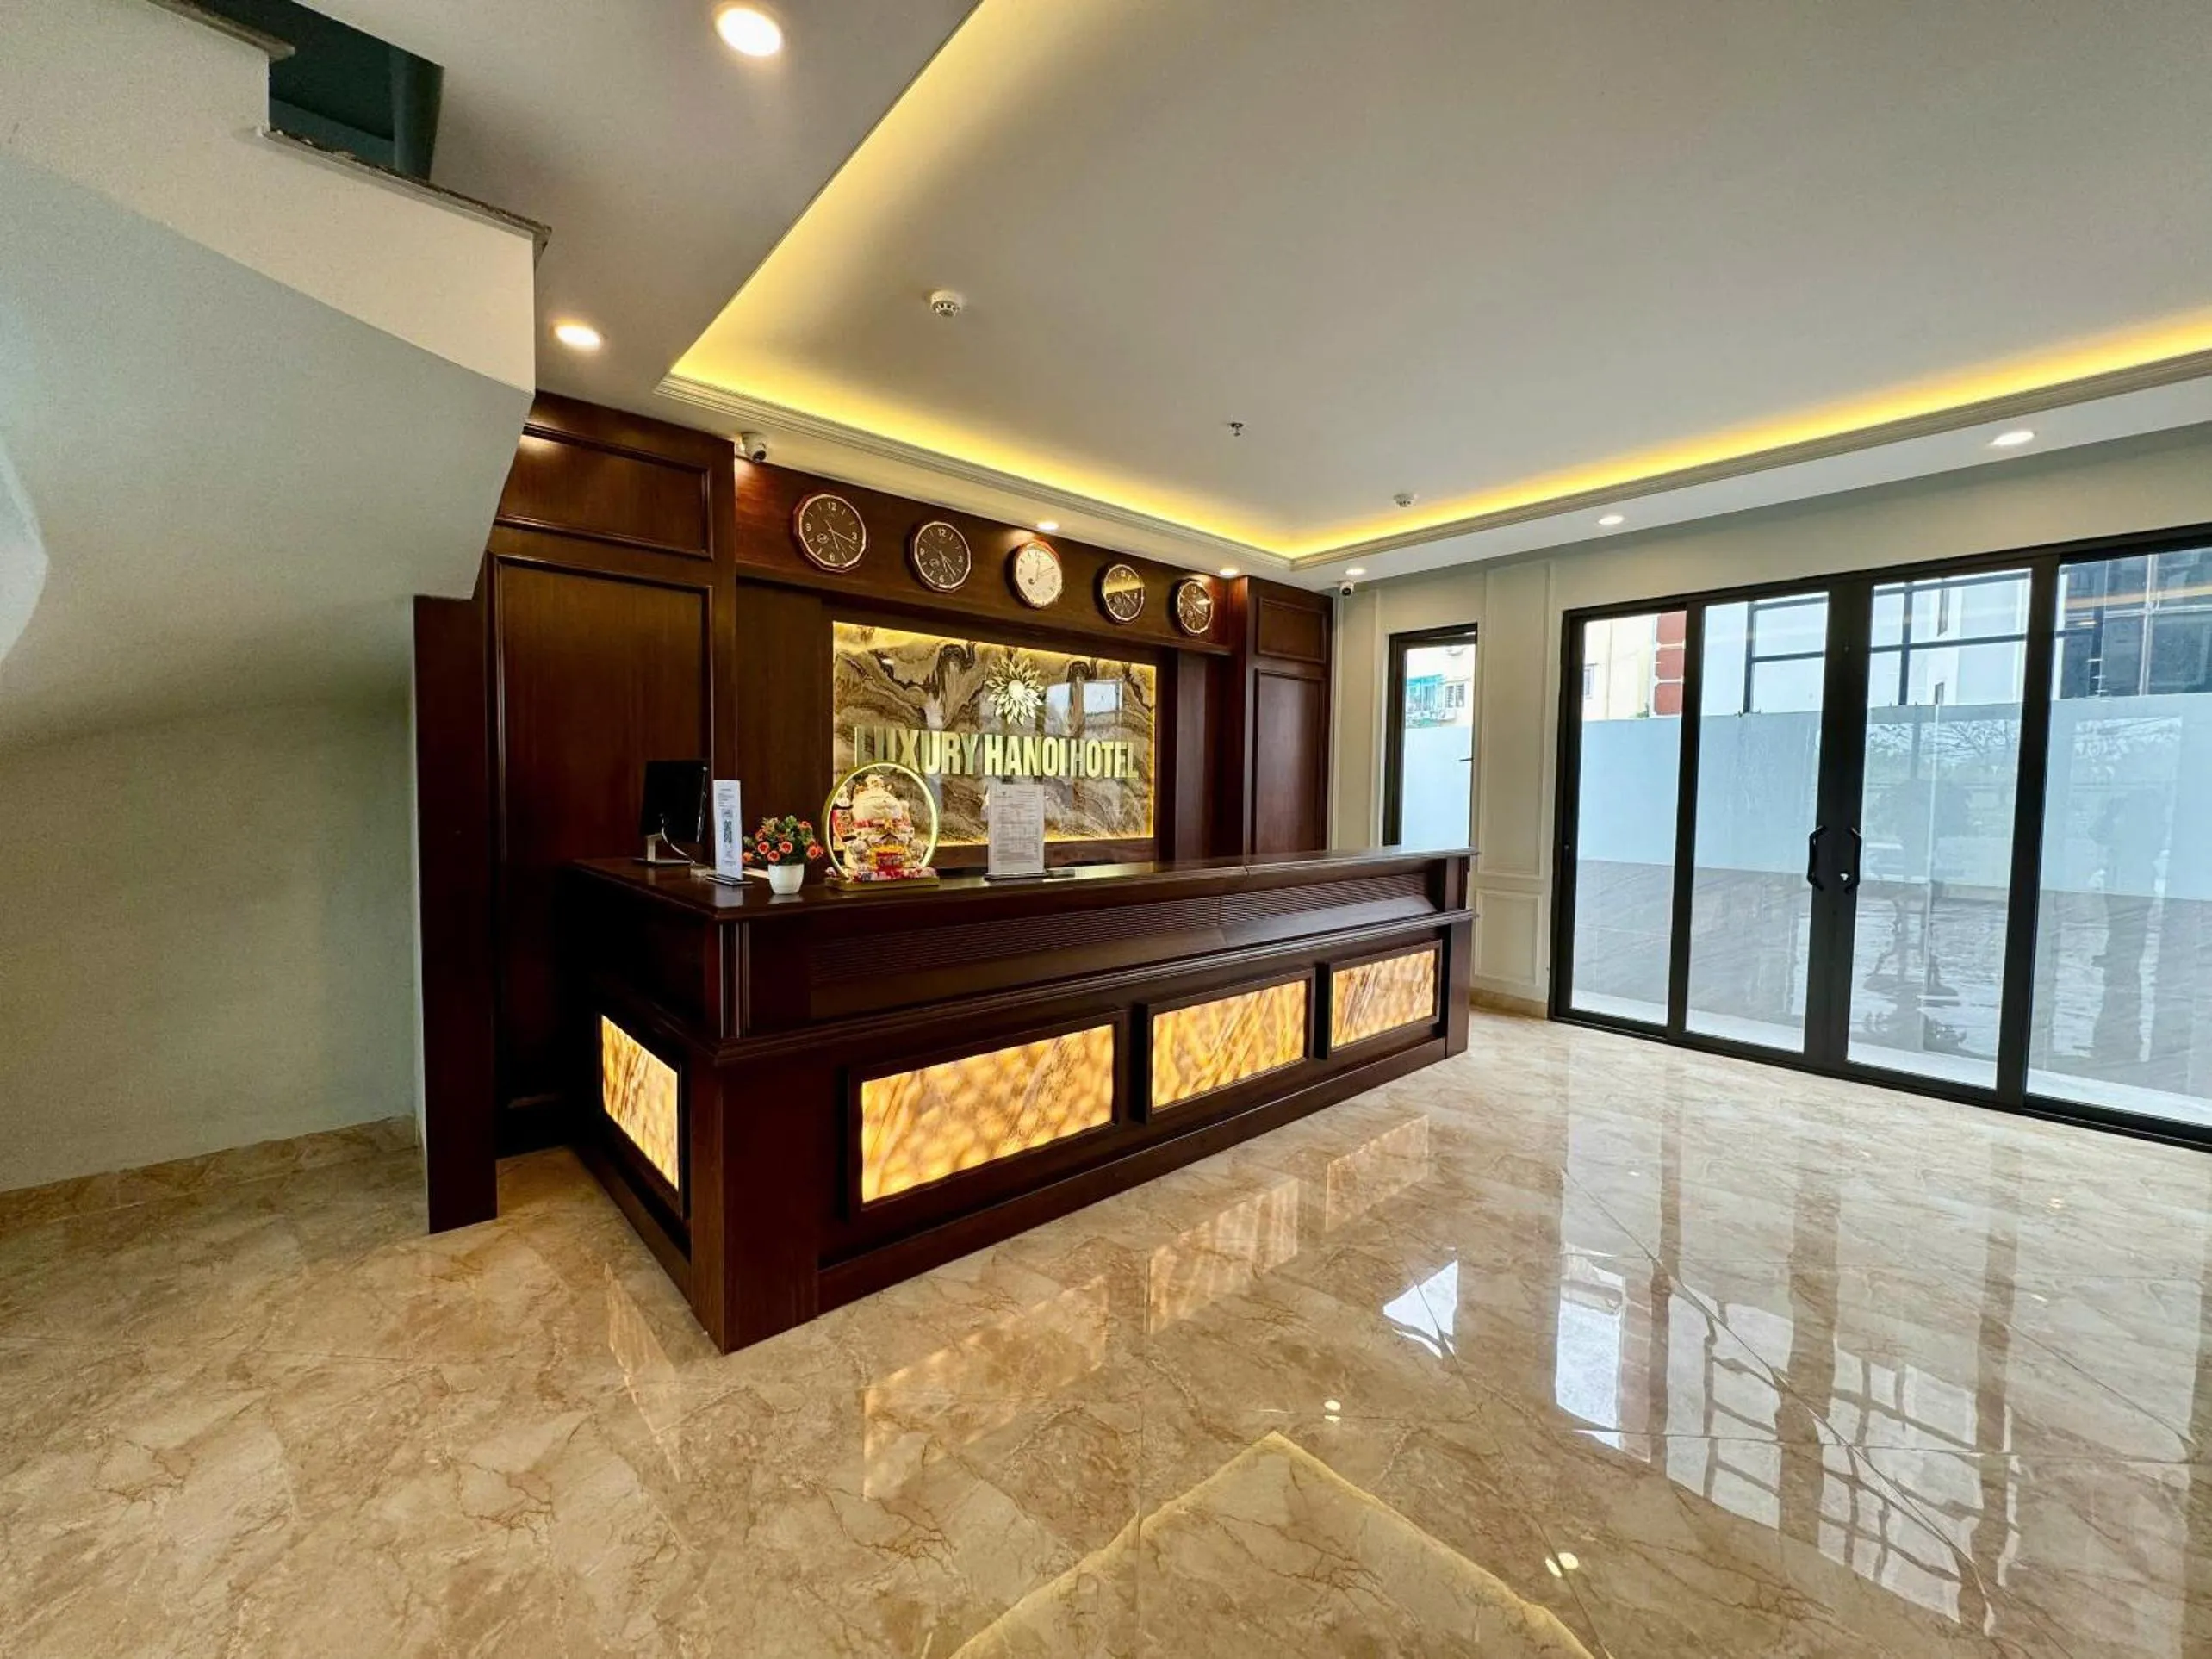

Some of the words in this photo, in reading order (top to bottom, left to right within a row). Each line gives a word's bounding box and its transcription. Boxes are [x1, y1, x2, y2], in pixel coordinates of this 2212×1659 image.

[828, 502, 837, 511] 12
[851, 531, 858, 541] 3
[938, 527, 947, 537] 12
[854, 725, 979, 775] LUXURY
[984, 733, 1066, 777] HANOI
[1070, 737, 1140, 779] HOTEL
